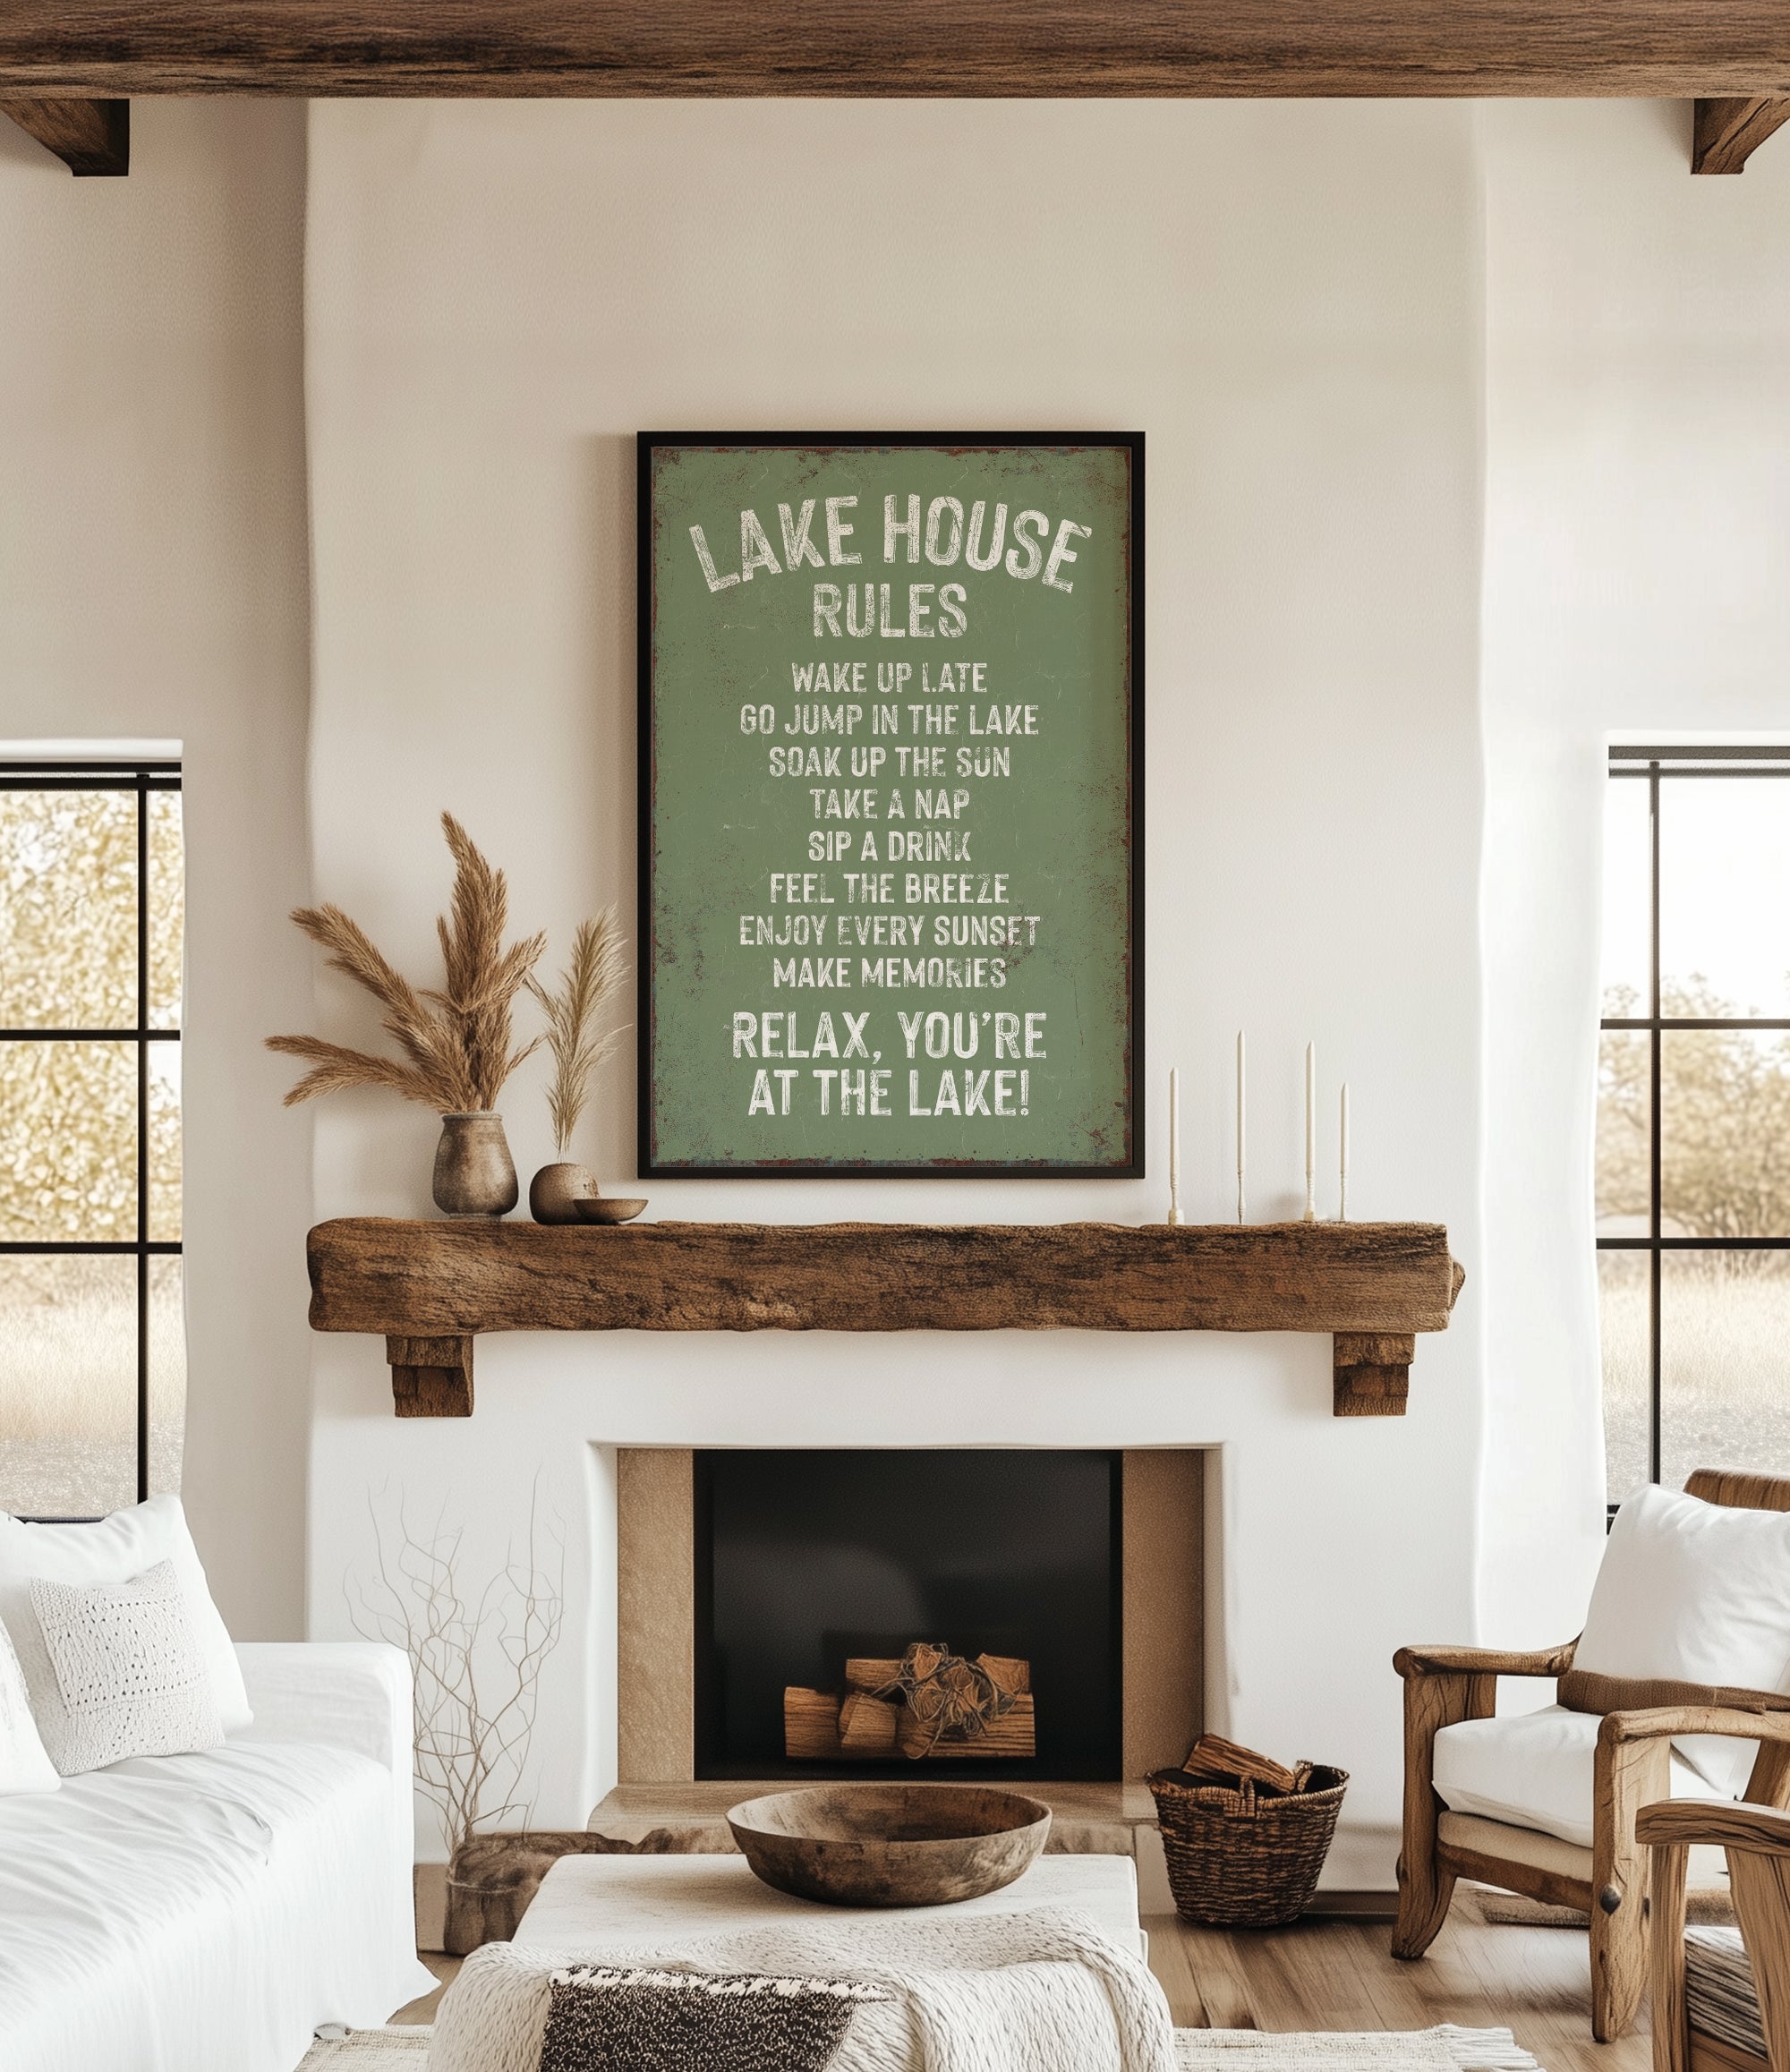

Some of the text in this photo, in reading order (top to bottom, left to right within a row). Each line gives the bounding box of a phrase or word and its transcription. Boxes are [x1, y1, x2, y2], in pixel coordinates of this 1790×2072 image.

[688, 493, 1093, 593] LAKE HOUSE
[813, 583, 967, 638] RULES
[791, 662, 987, 693] WAKE UP LATE
[740, 704, 1039, 735] GO JUMP IN THE LAKE
[769, 746, 1010, 777] SOAK UP THE SUN
[809, 789, 970, 819] TAKE A NAP
[808, 831, 971, 862] SIP A DRINK
[770, 873, 1010, 904] FEEL THE BREEZE
[739, 915, 1041, 946] ENJOY EVERY SUNSET
[773, 958, 1006, 988] MAKE MEMORIES
[732, 1011, 1047, 1065] RELAX, YOU'RE
[747, 1069, 1028, 1117] AT THE LAKE!
